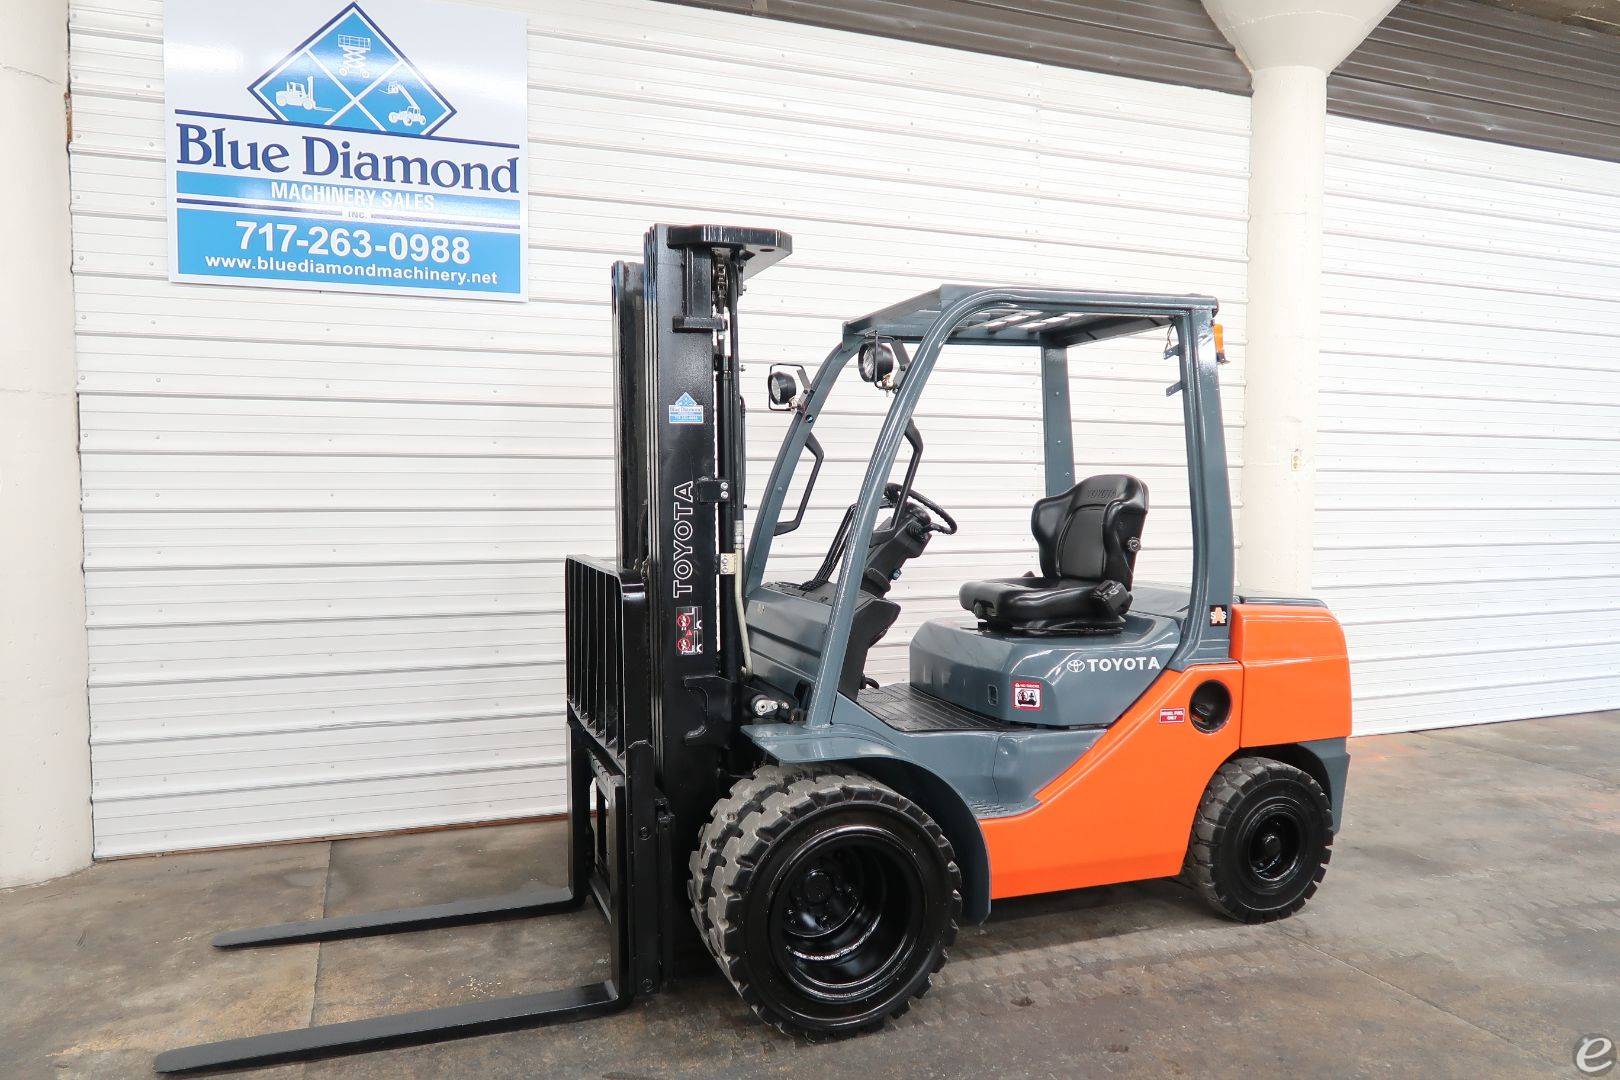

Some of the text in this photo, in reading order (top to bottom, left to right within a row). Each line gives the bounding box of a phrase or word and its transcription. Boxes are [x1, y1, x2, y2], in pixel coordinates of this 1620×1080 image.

[176, 123, 520, 193] Blue Diamond
[271, 181, 435, 210] MACHINERY SALES
[235, 220, 471, 264] 717-263-0988
[205, 253, 498, 285] www.bluediamondmachinery.net
[673, 480, 694, 599] TOYOTA
[1086, 656, 1161, 673] TOYOTA
